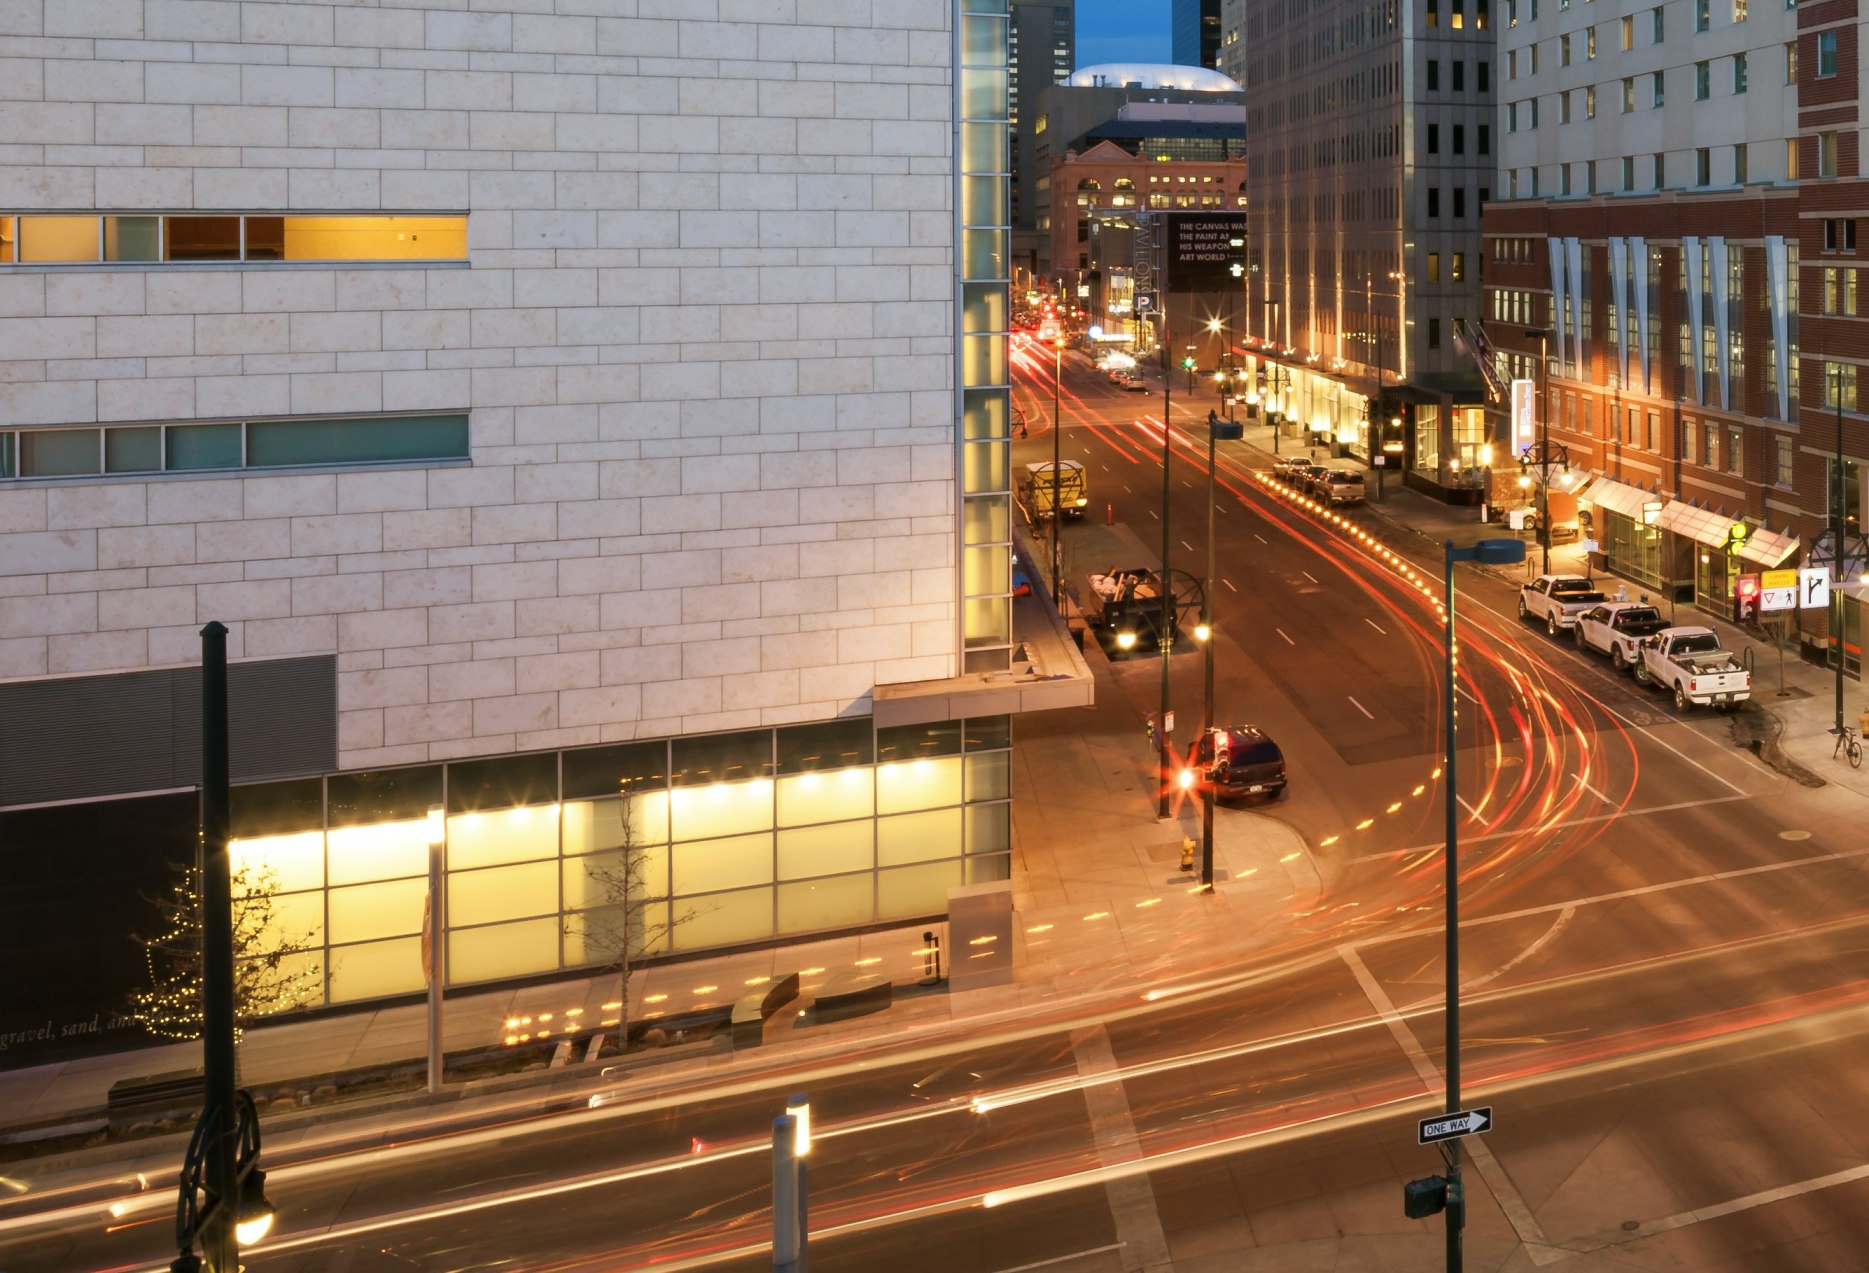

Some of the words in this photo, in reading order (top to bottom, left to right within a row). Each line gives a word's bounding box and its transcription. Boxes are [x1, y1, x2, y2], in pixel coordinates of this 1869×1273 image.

[1195, 223, 1230, 231] CANVAS
[1180, 253, 1195, 261] ART
[1196, 253, 1226, 261] WORLD
[61, 1013, 103, 1037] sand,
[107, 1008, 138, 1030] and
[1426, 1123, 1447, 1136] ONE
[1449, 1118, 1470, 1131] WAY
